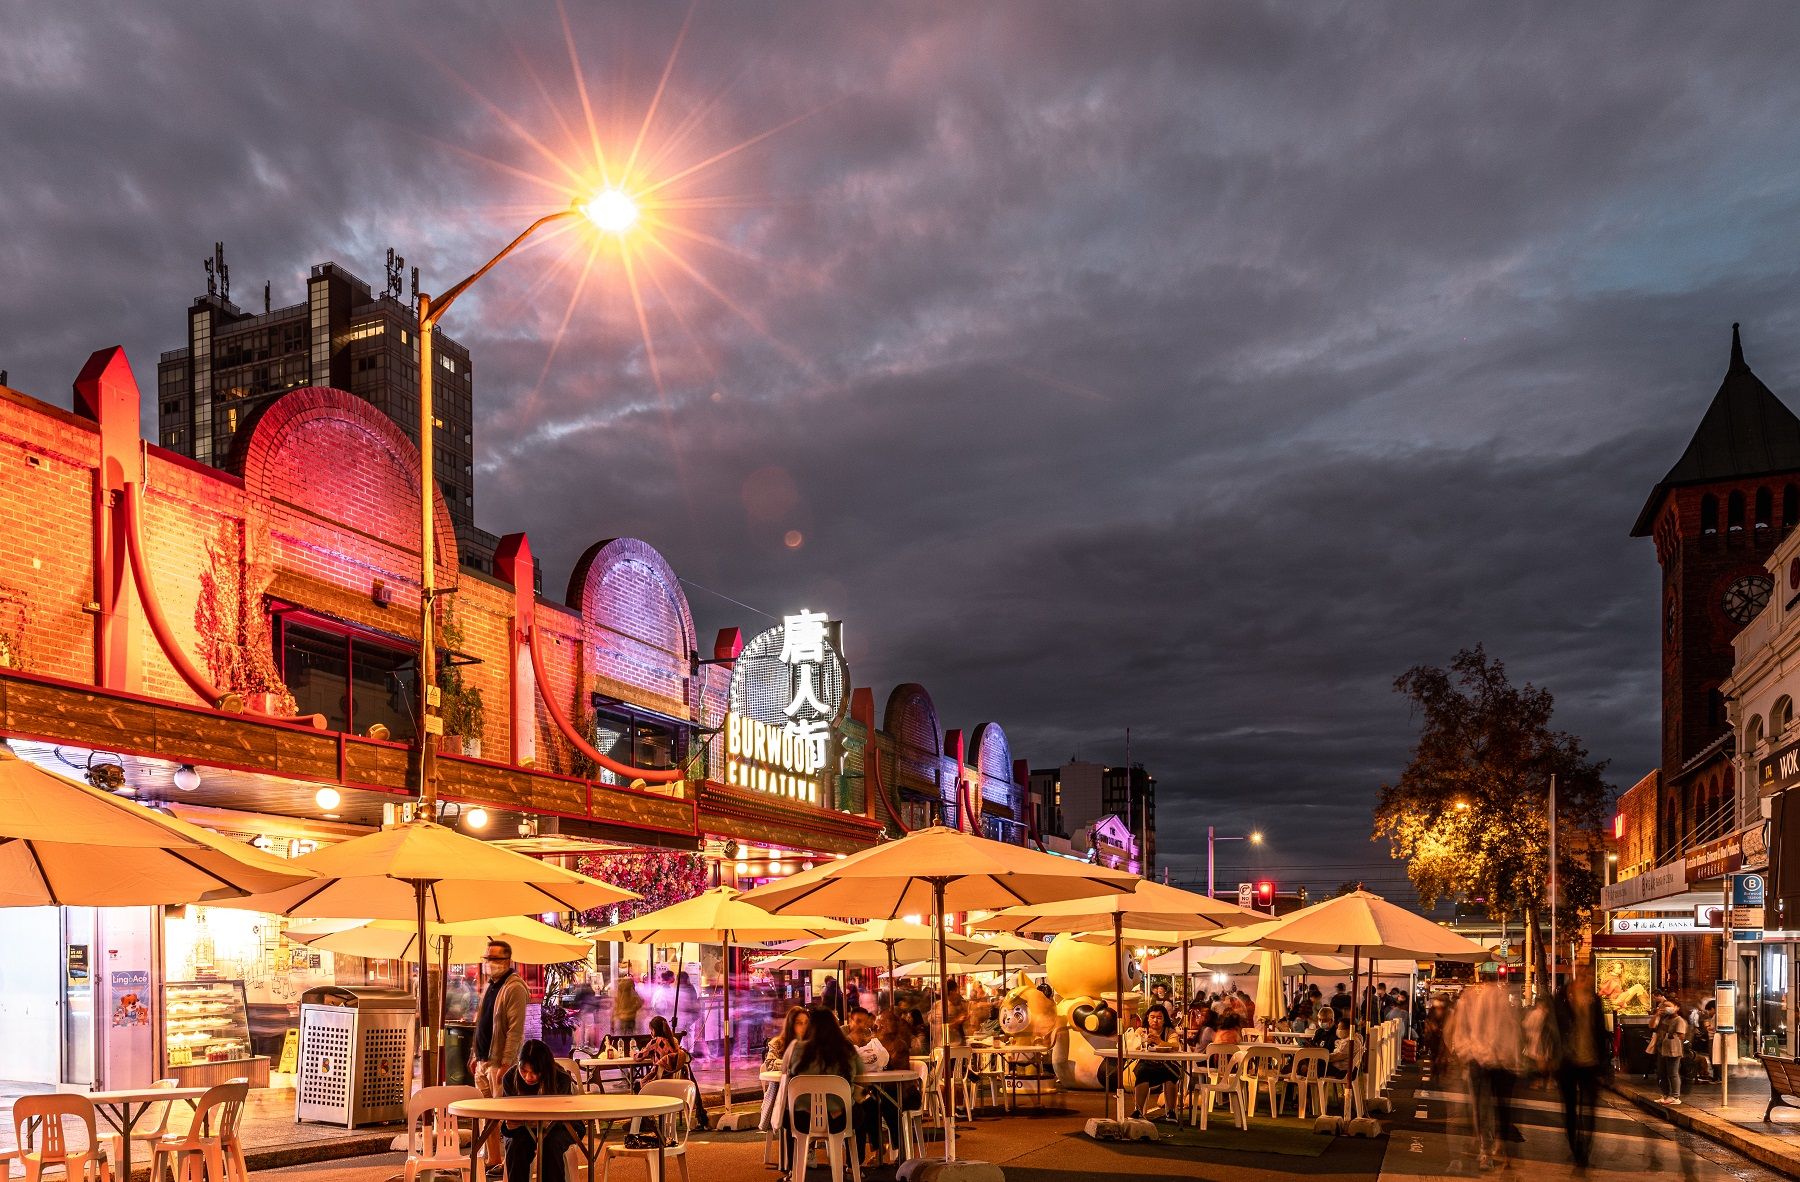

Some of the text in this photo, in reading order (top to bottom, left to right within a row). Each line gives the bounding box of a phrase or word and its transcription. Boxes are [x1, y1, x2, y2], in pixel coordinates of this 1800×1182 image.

[779, 608, 831, 769] 唐人街
[728, 712, 816, 775] BURWOOD
[728, 761, 816, 802] CHINATOWN
[1748, 879, 1756, 888] B
[112, 974, 147, 985] LingoAce
